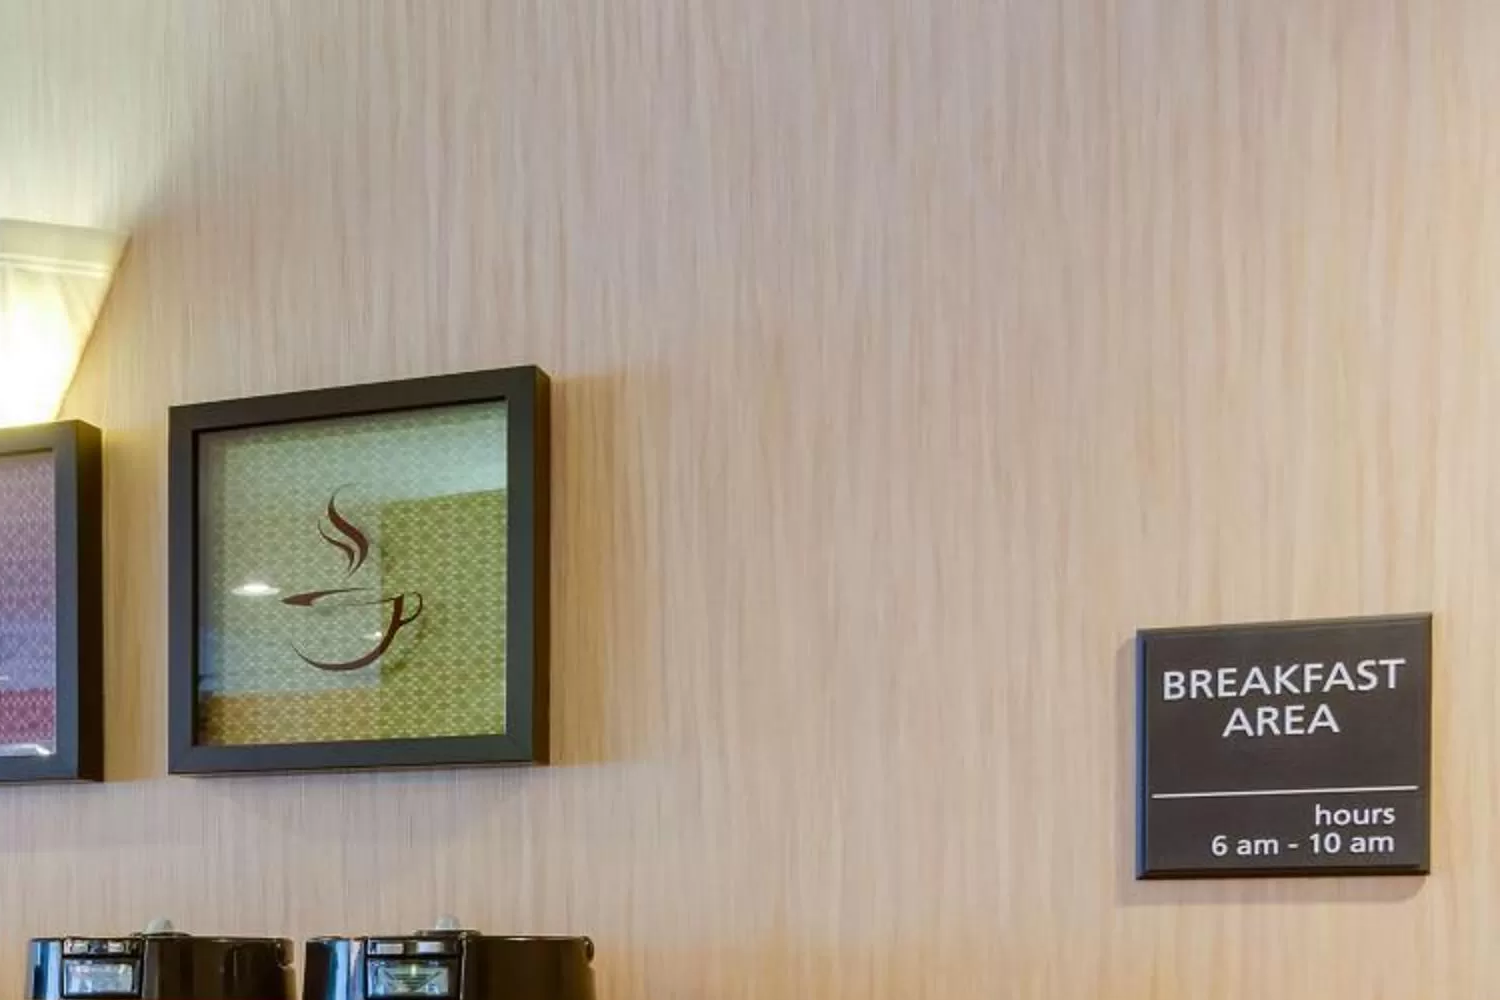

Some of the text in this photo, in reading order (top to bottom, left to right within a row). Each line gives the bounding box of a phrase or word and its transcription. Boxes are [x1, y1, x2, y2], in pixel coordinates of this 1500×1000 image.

[1162, 658, 1407, 700] BREAKFAST
[1222, 703, 1341, 738] AREA
[1314, 804, 1396, 827] hours
[1211, 834, 1228, 857] 6
[1236, 837, 1279, 856] am
[1309, 833, 1342, 854] 10
[1350, 835, 1395, 854] am
